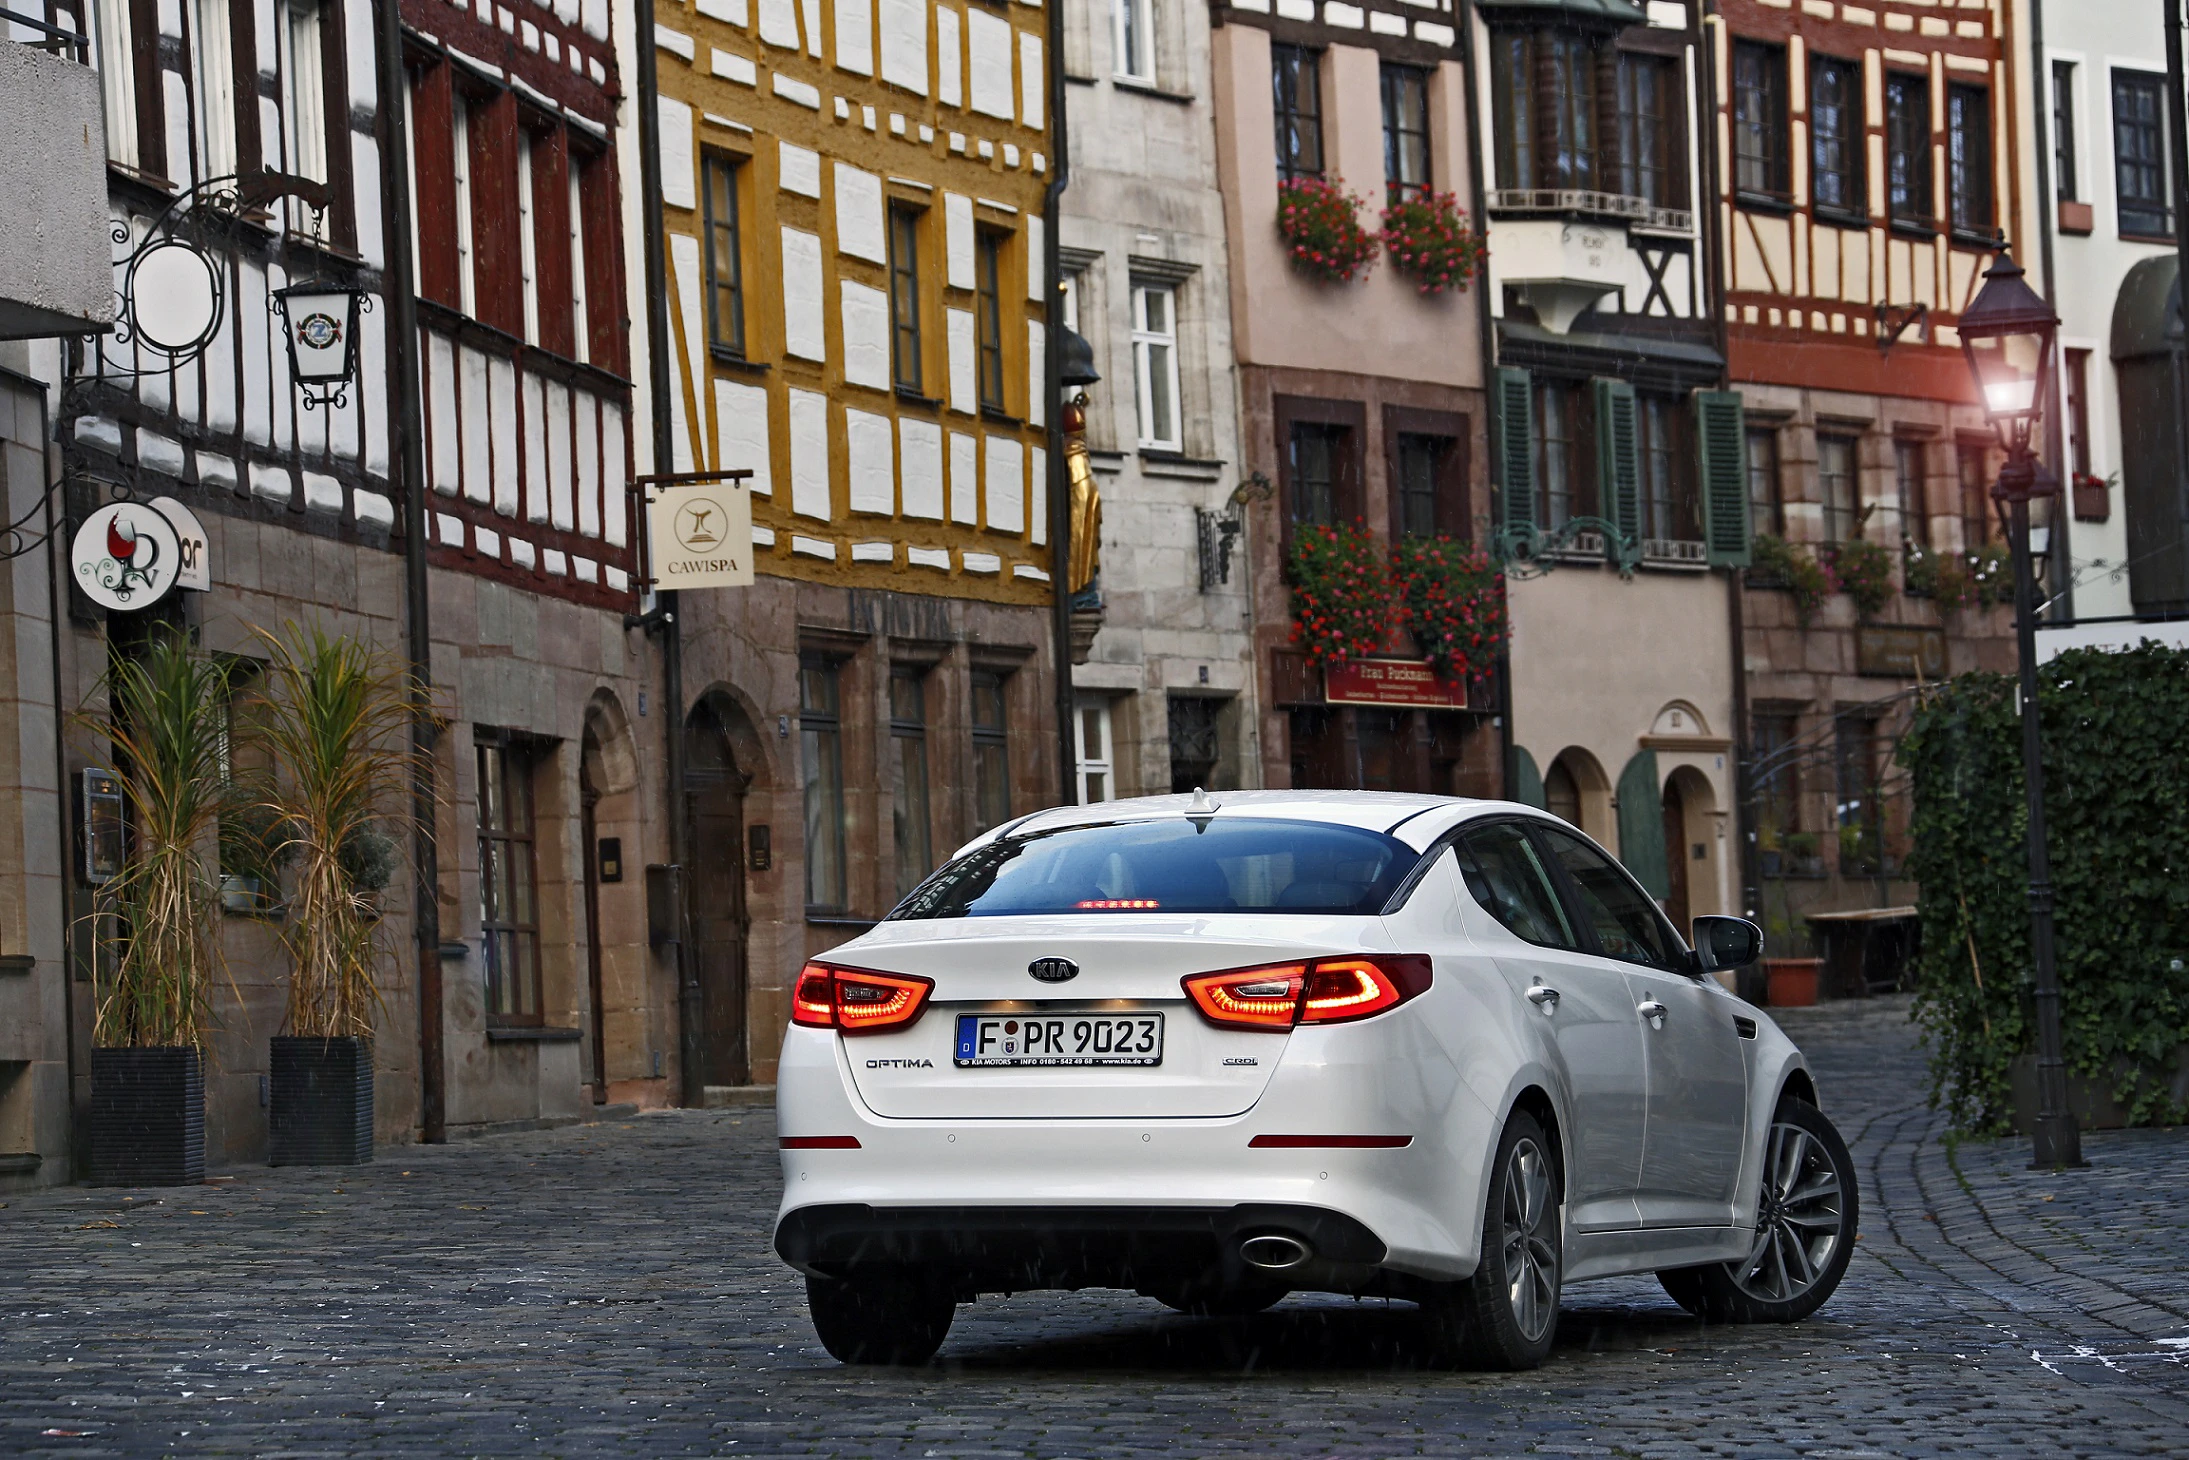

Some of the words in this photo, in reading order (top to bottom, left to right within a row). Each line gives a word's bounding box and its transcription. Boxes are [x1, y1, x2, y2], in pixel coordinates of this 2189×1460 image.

[667, 559, 738, 575] CAWISPA
[1035, 962, 1071, 978] KIA
[978, 1022, 1000, 1054] F
[1023, 1021, 1065, 1054] PR
[1073, 1020, 1156, 1053] 9023
[865, 1059, 934, 1069] OPTIMA
[971, 1058, 984, 1066] KIA
[983, 1058, 1012, 1066] MOTORS
[1020, 1058, 1038, 1066] INFO
